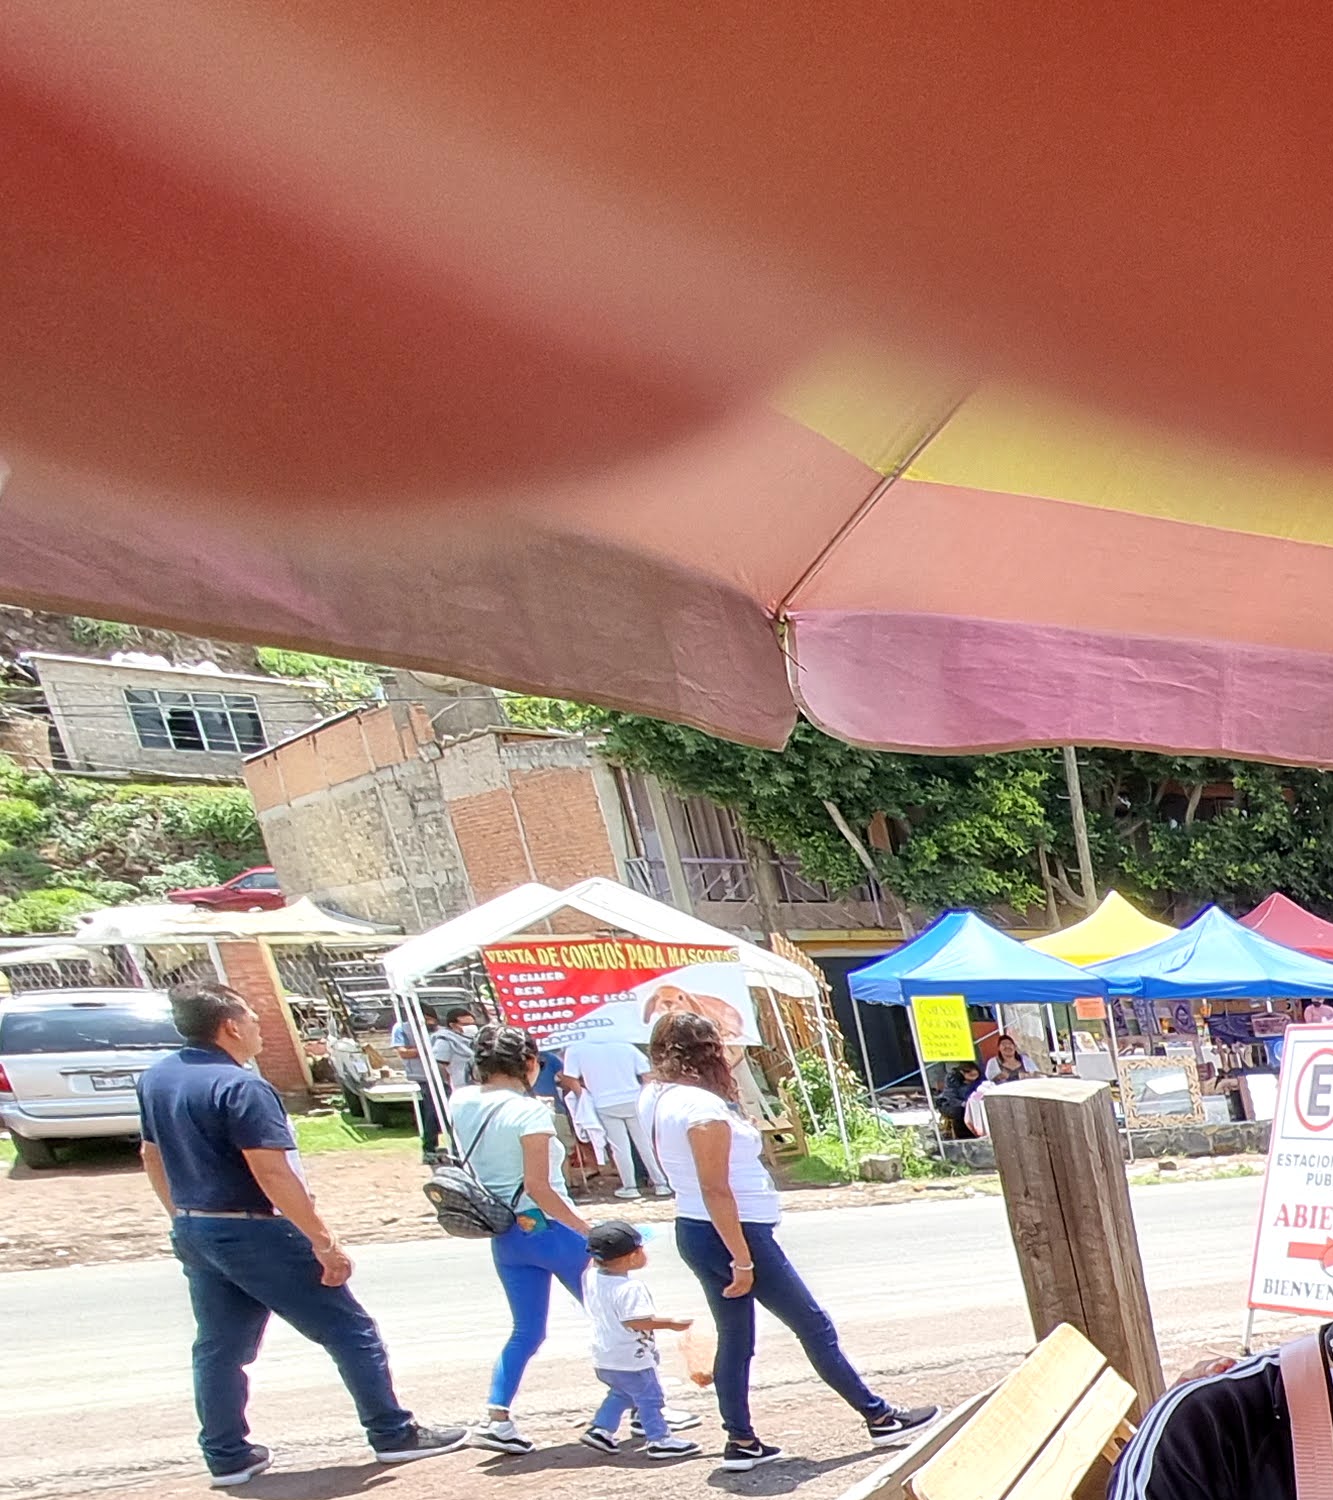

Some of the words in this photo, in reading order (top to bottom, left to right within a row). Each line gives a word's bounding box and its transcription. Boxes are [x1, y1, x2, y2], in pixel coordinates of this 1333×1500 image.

[484, 948, 538, 966] VENTA
[536, 946, 562, 968] DE
[560, 942, 628, 970] CONEJOS
[625, 944, 668, 970] PARA
[667, 947, 740, 968] MASCOTAS
